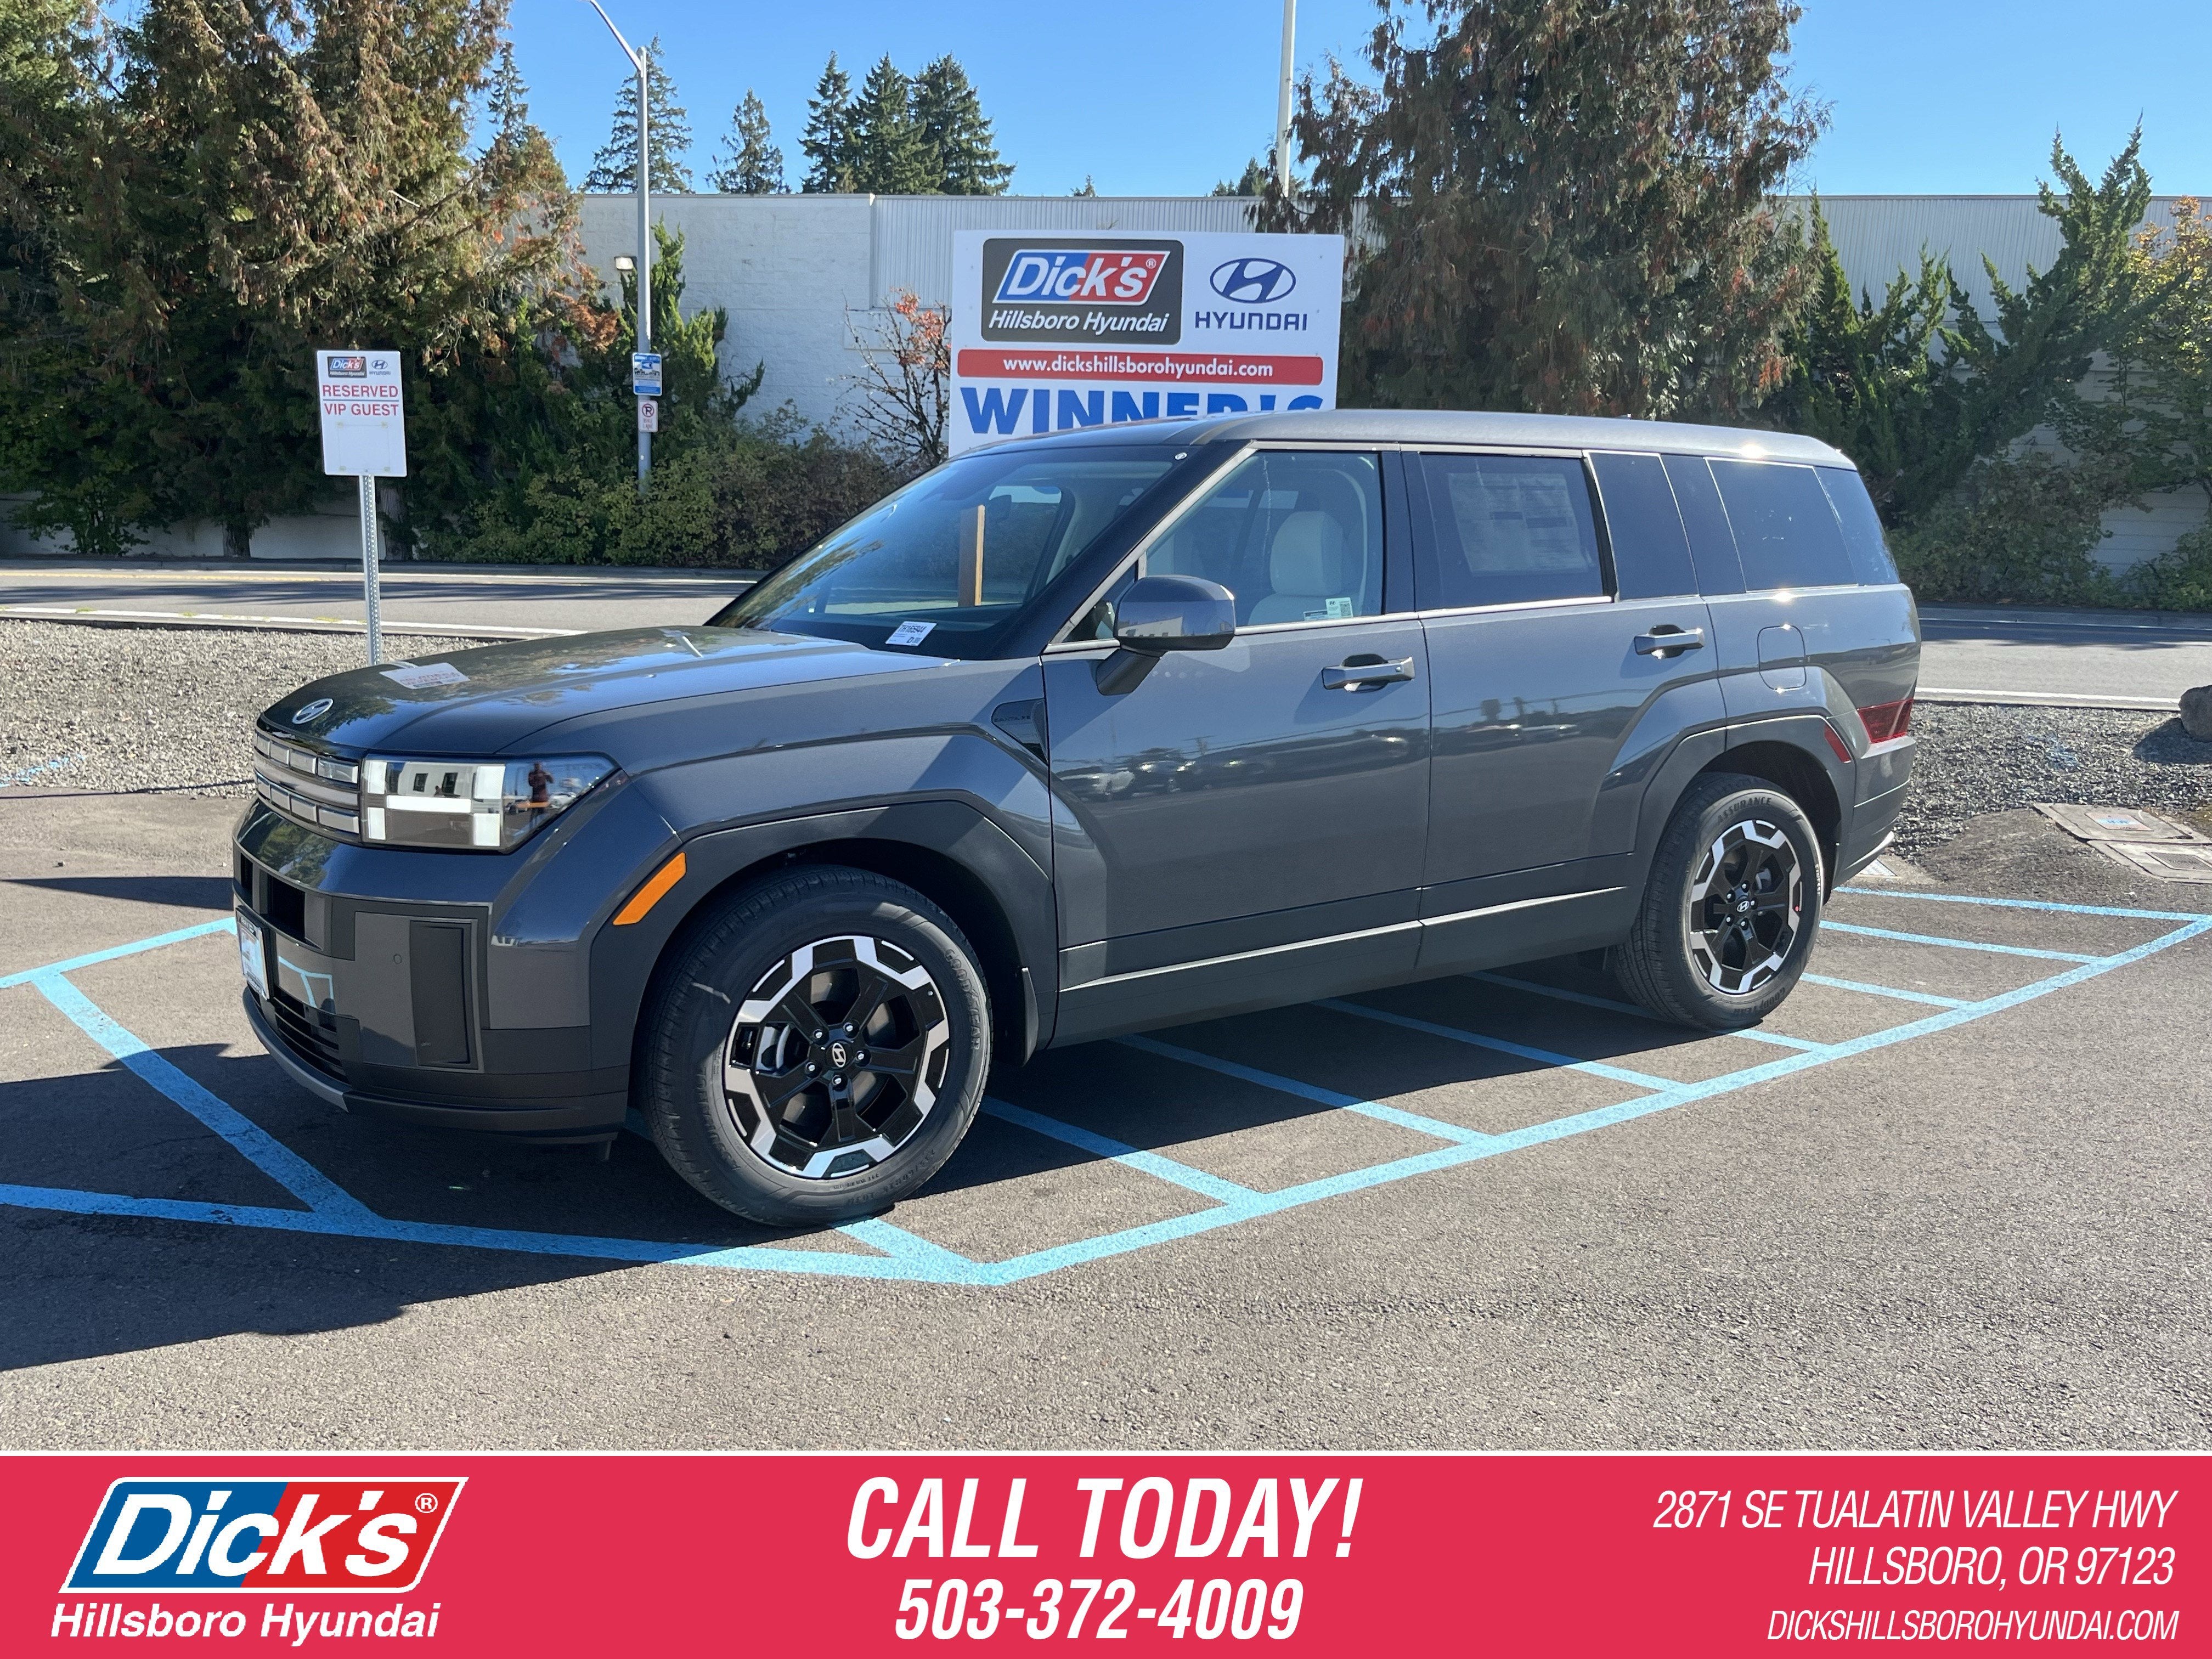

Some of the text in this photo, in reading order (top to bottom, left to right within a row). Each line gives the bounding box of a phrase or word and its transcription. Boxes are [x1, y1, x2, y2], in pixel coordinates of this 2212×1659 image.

[989, 310, 1170, 335] Hillsboro Hyundai
[1195, 311, 1307, 331] HYUNDAI
[1003, 354, 1273, 379] www.dickshillsborohyundai.com
[323, 385, 398, 398] RESERVED
[324, 403, 399, 416] VIP GUEST
[1718, 797, 1772, 824] ASSURANCE
[944, 949, 981, 1050] GOODYEAR
